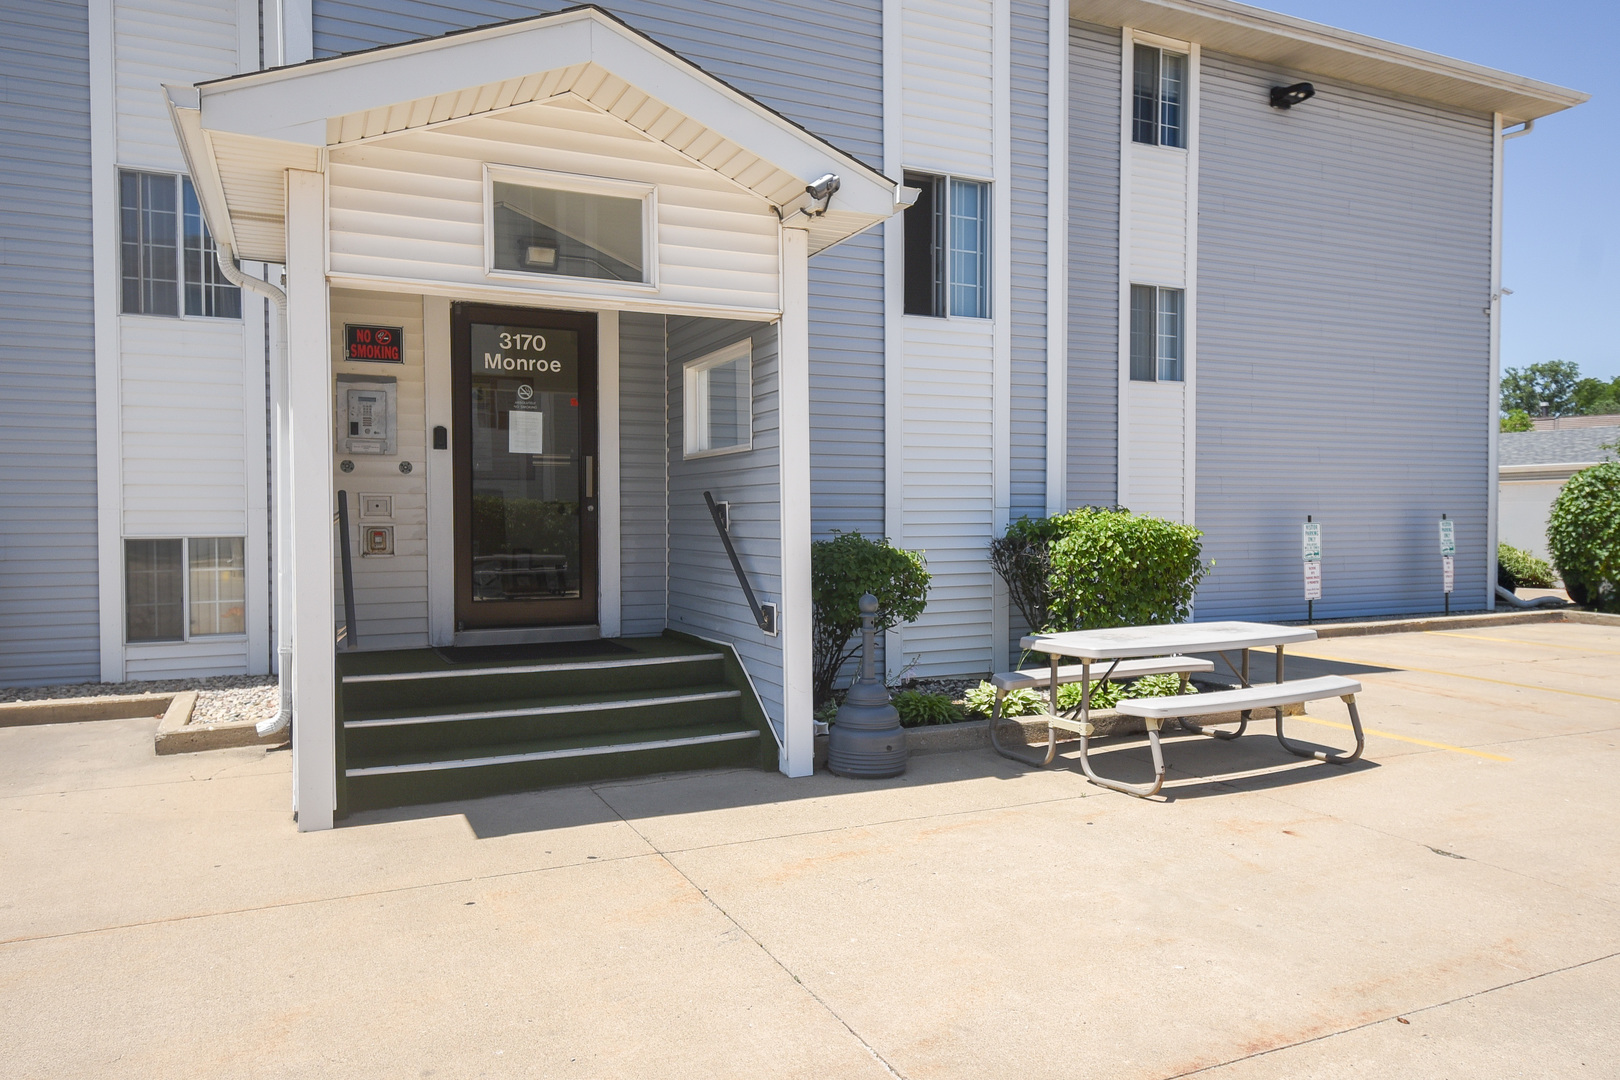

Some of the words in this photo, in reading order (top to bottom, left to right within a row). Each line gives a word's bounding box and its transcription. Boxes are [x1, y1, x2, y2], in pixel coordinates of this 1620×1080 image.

[356, 329, 371, 343] NO
[499, 332, 546, 352] 3170
[351, 344, 399, 360] SMOKING
[484, 352, 562, 373] Monroe
